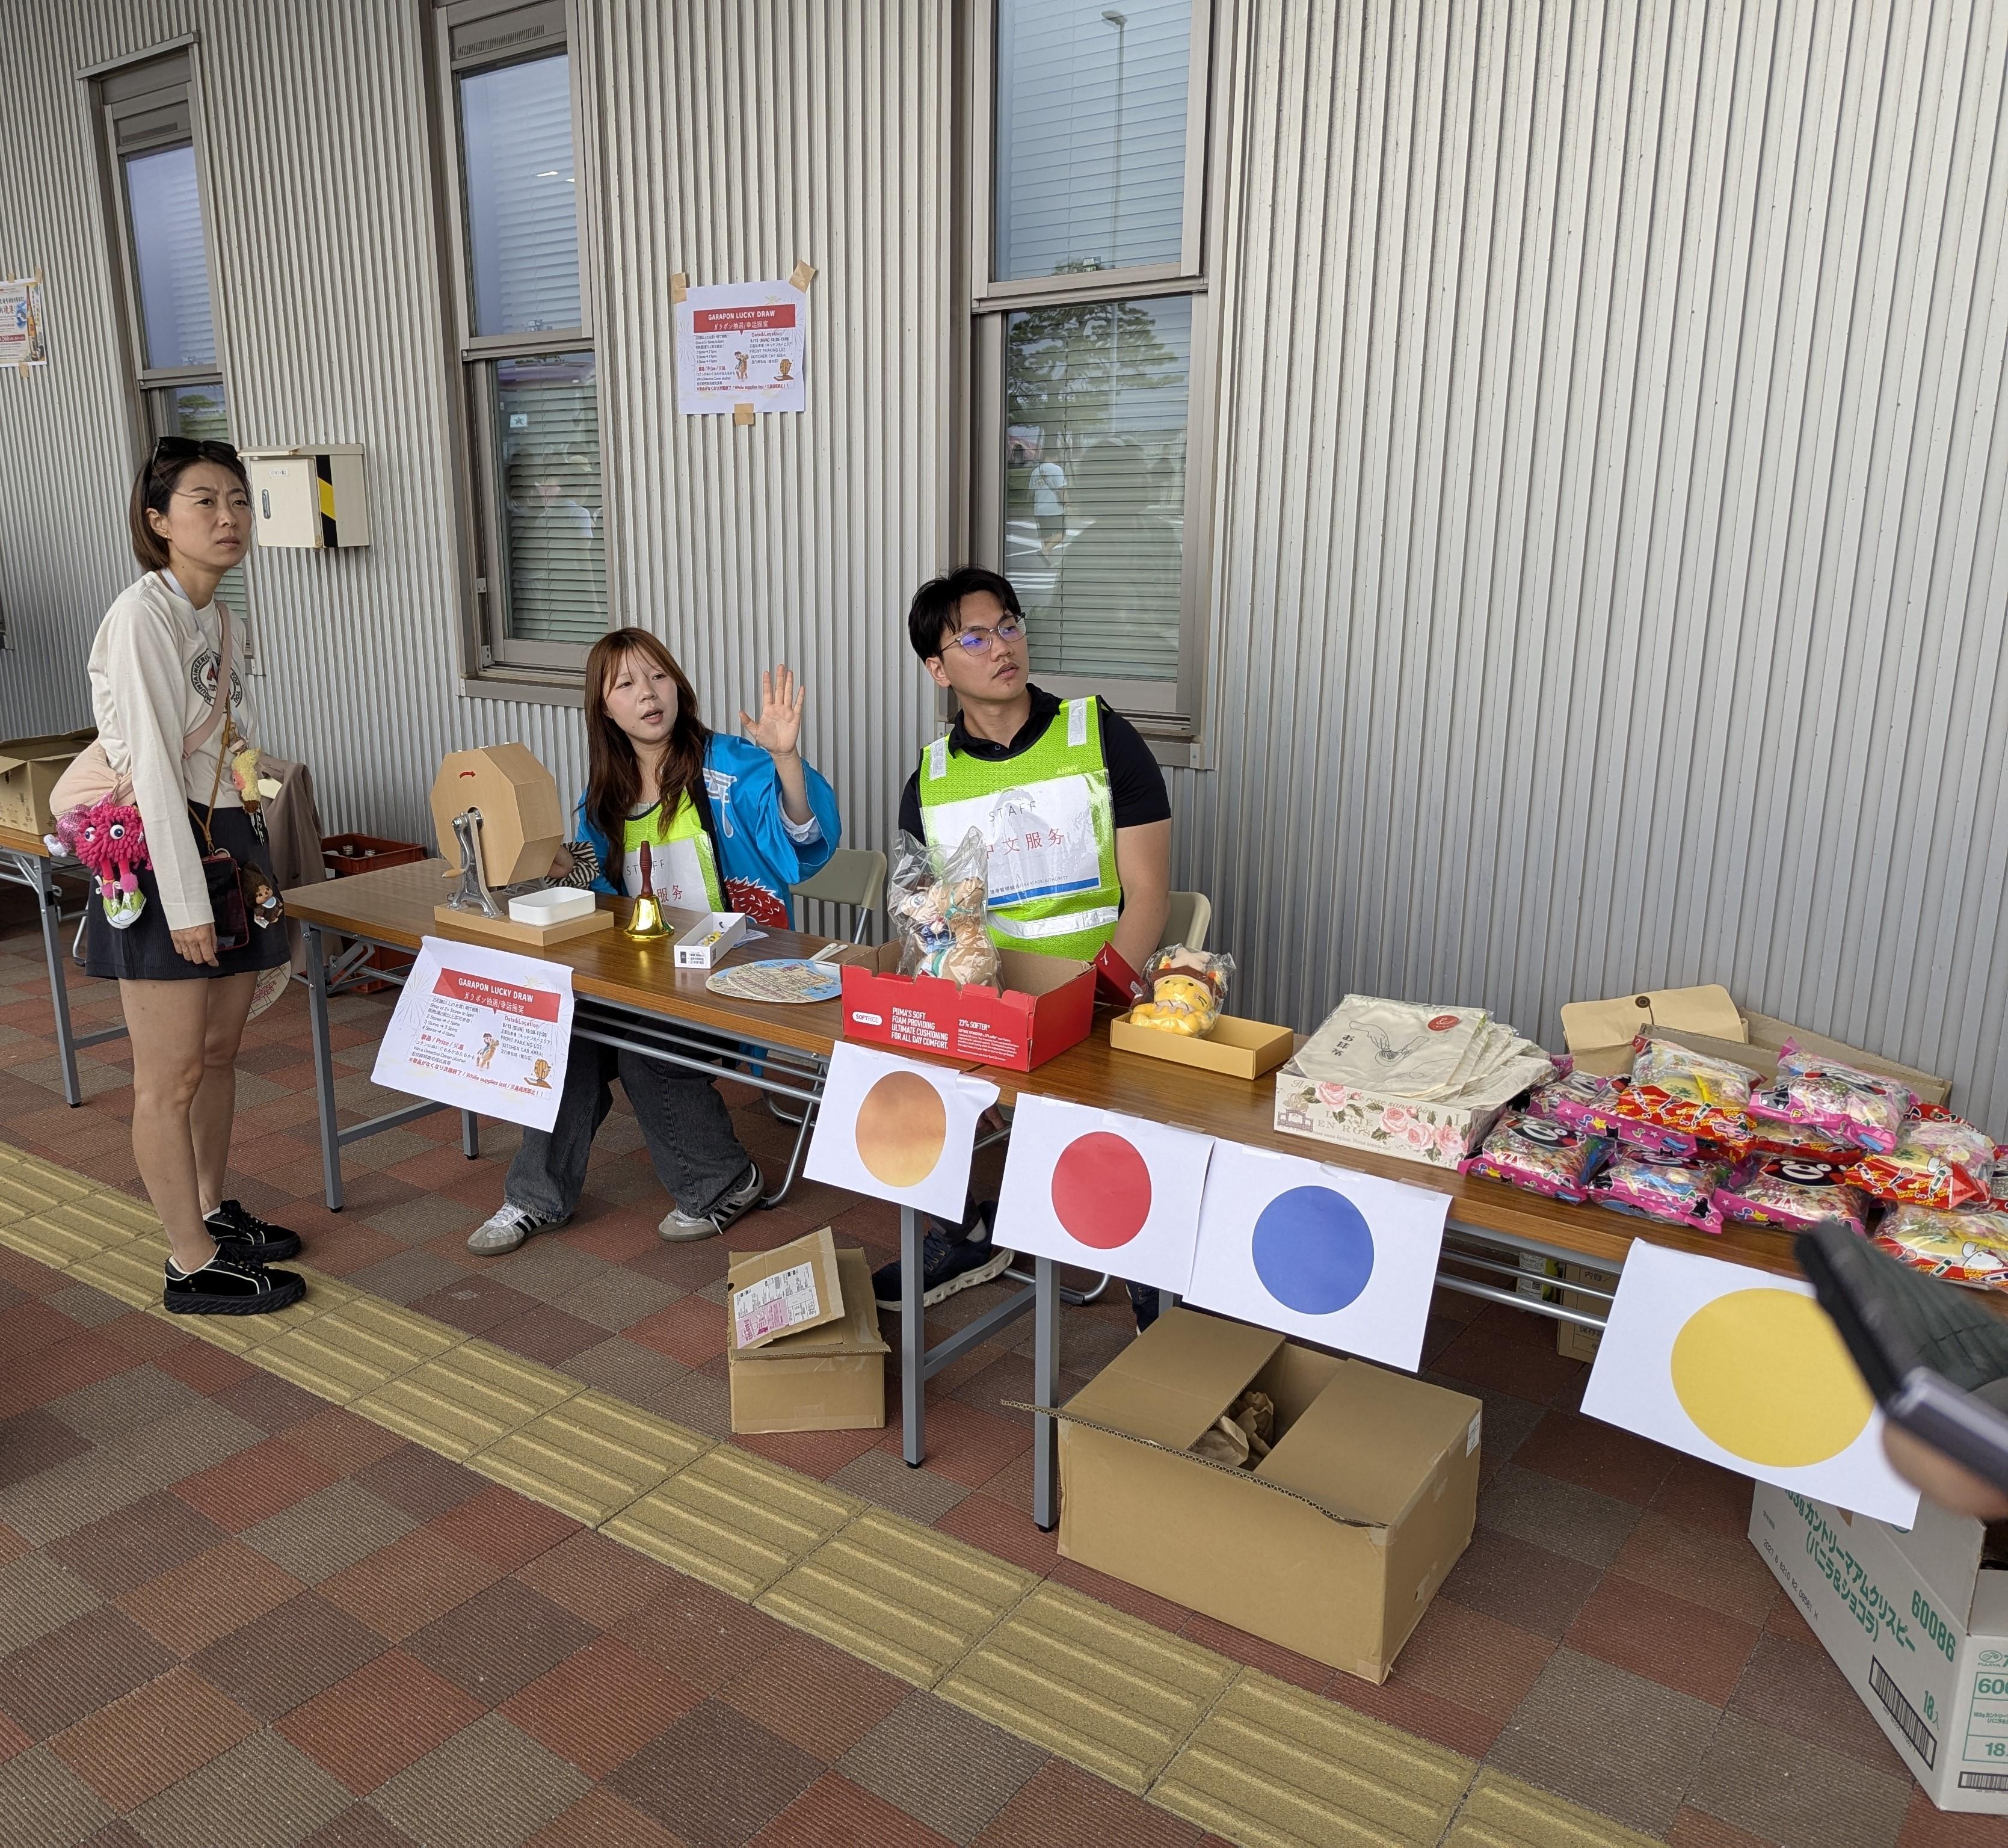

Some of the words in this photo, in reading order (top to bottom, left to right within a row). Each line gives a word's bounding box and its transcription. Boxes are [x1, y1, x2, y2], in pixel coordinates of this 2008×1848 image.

[708, 312, 735, 321] GARAPON
[736, 310, 755, 319] LUCKY
[989, 801, 1036, 822] STAFF
[626, 859, 665, 876] STFF
[458, 978, 489, 993] GARAPON
[490, 985, 512, 998] LUCKY
[513, 990, 534, 1003] DRAW
[855, 1014, 879, 1023] SOFTRIDE
[892, 1007, 912, 1018] PUMA'S
[913, 1011, 926, 1020] SOFT
[504, 1015, 539, 1028] Date&Location
[892, 1015, 907, 1024] FOAM
[907, 1018, 935, 1030] PROVIDING
[958, 1019, 970, 1027] 23%
[892, 1023, 916, 1035] ULTIMATE
[916, 1028, 949, 1041] CUSHIONING
[514, 1038, 532, 1047] PARKING
[891, 1031, 901, 1040] FOR
[902, 1034, 912, 1043] ALL
[912, 1036, 923, 1045] DAY
[923, 1038, 949, 1050] COMFORT.
[479, 1076, 498, 1086] supplies
[1317, 1120, 1335, 1130] EN
[1342, 1124, 1371, 1137] ROS
[1911, 1590, 1956, 1662] 60086
